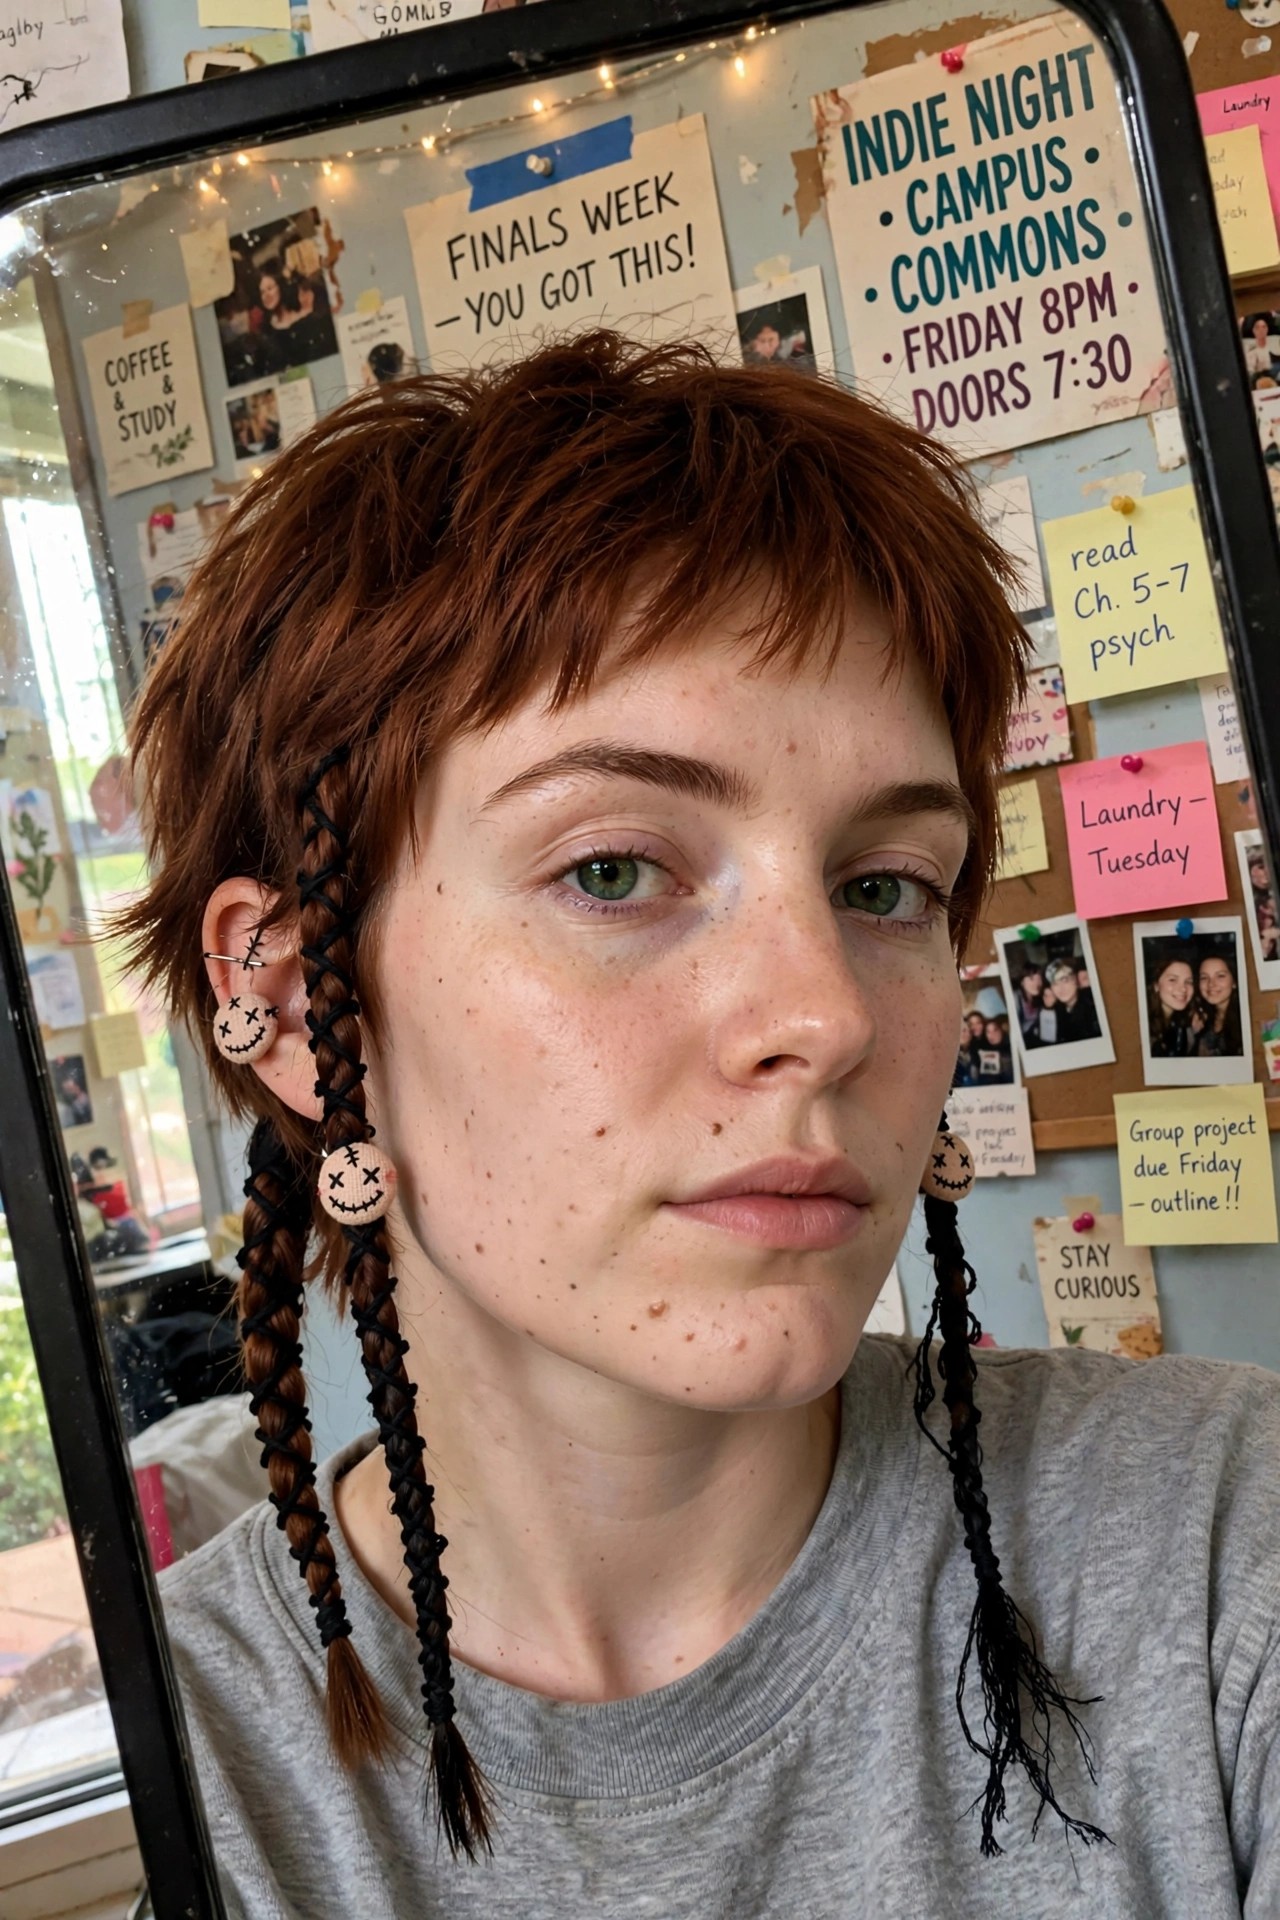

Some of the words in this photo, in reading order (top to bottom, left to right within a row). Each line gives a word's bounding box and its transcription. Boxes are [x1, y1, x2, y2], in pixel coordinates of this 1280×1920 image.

[841, 92, 955, 186] INDIE
[964, 43, 1095, 146] NIGHT
[1223, 93, 1270, 113] Laundry
[906, 136, 1073, 236] CAMPUS
[446, 207, 569, 281] FINALS
[581, 171, 680, 235] WEEK
[540, 259, 596, 310] GOT
[609, 223, 695, 288] THIS!
[890, 198, 1107, 314] COMMONS
[903, 296, 1023, 374] FRIDAY
[1040, 271, 1118, 335] 8PM
[104, 341, 173, 387] COFFEE
[912, 361, 1031, 435] DOORS
[1043, 333, 1132, 400] 7:30
[114, 391, 125, 411] &
[163, 374, 174, 394] &
[118, 400, 177, 441] STUDY
[1071, 525, 1137, 572] read
[1075, 582, 1120, 618] Ch.
[1133, 562, 1189, 604] 5-7
[1091, 613, 1175, 672] psych
[1081, 789, 1181, 829] Laundry
[1088, 839, 1189, 876] Tuesday
[1130, 1119, 1184, 1148] Group
[1194, 1114, 1257, 1147] project
[1134, 1154, 1169, 1178] due
[1180, 1150, 1242, 1183] Friday
[1060, 1243, 1110, 1268] STAY
[1055, 1274, 1140, 1300] CURIOUS
